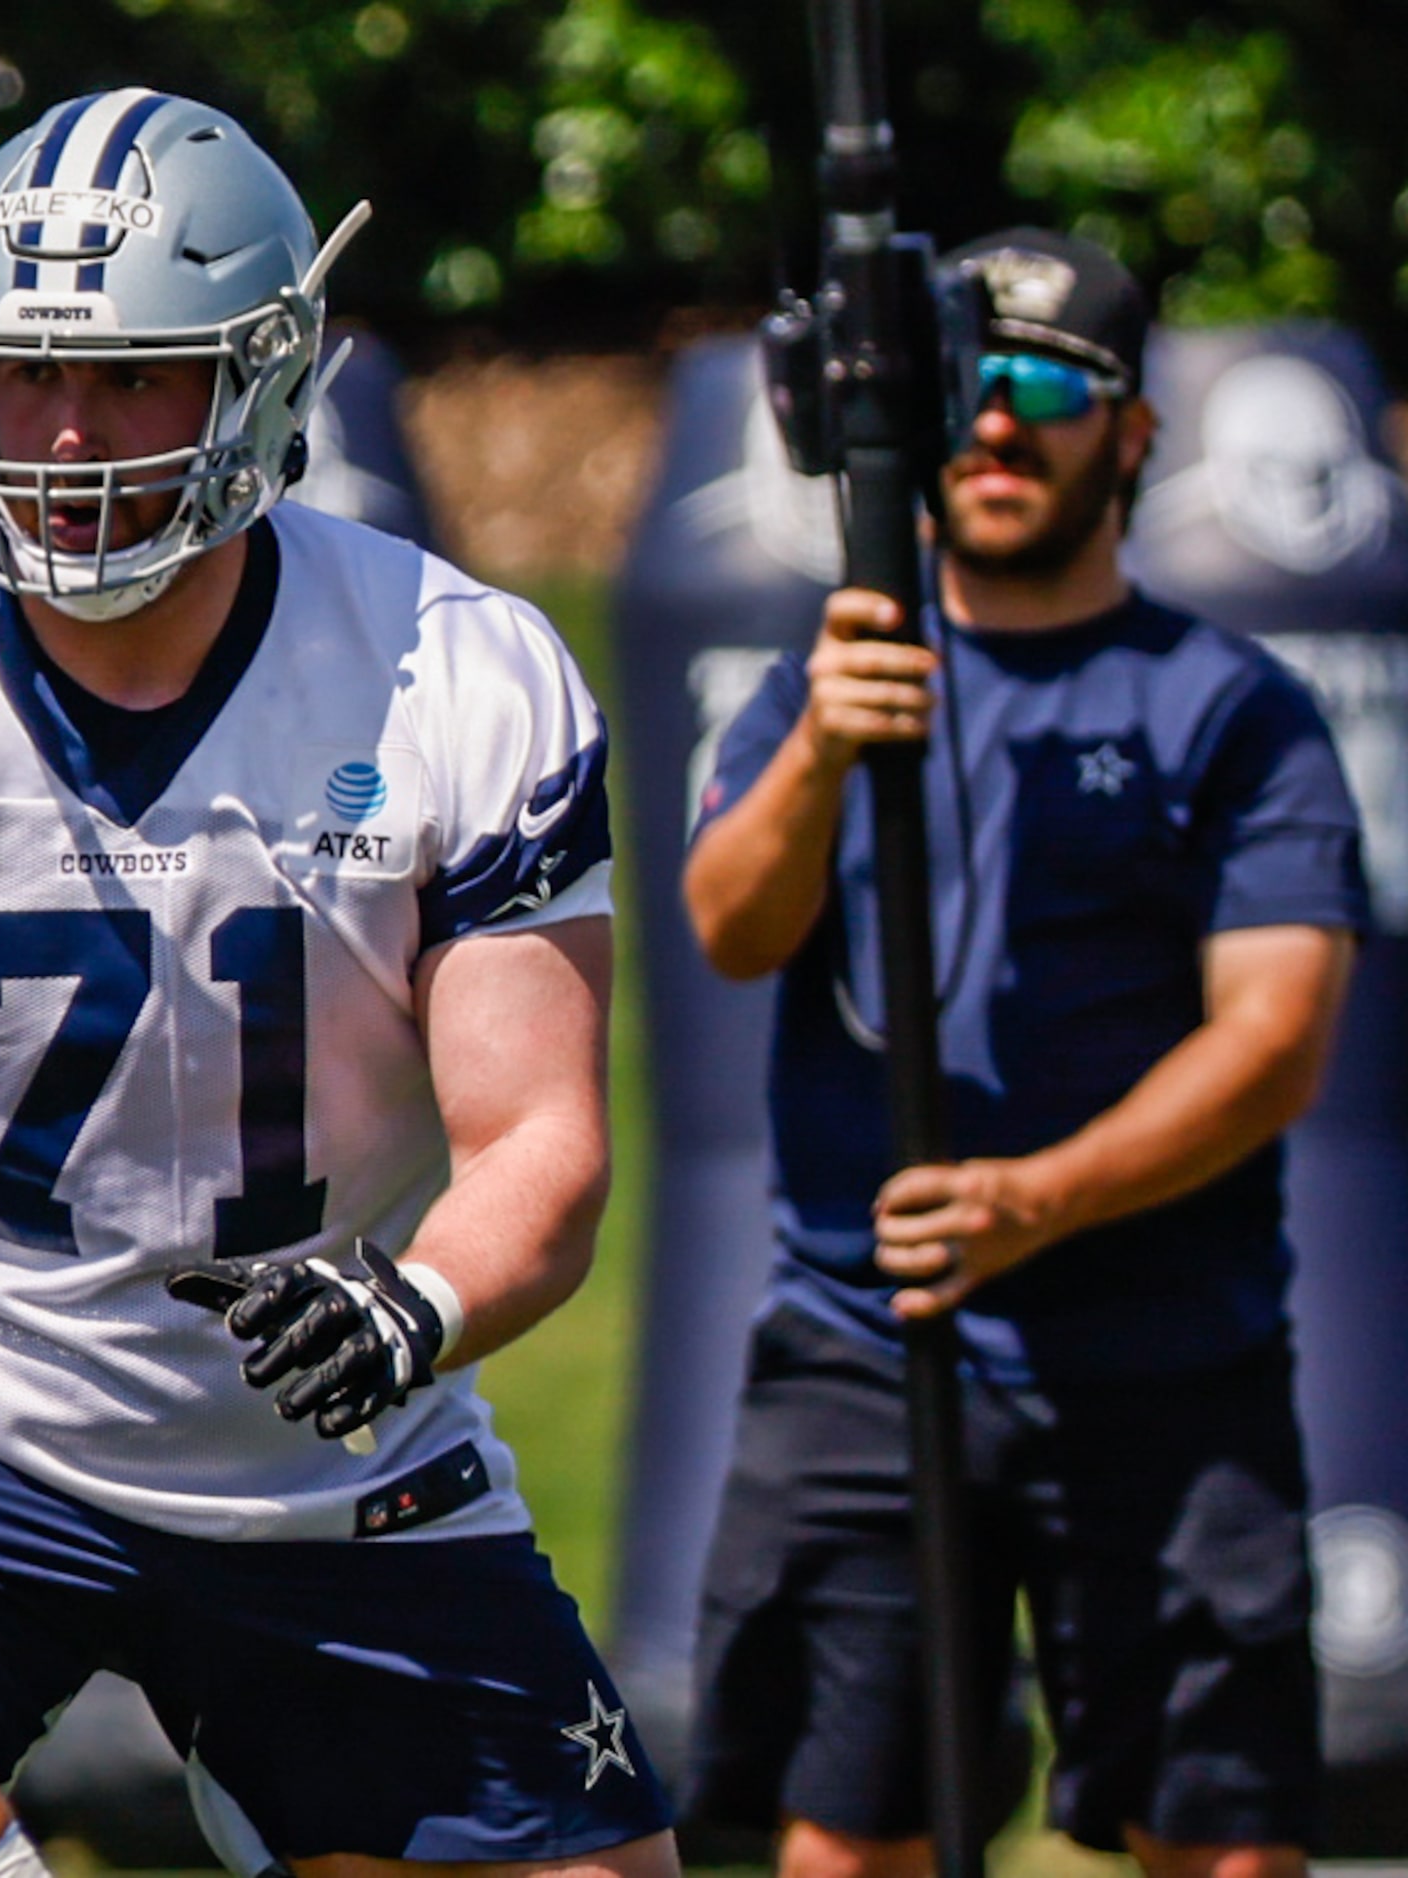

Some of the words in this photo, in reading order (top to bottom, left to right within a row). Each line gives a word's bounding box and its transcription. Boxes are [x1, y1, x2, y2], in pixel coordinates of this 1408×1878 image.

[18, 307, 93, 320] COWBOYS
[313, 832, 391, 862] AT&T
[60, 851, 187, 876] COWBOYS
